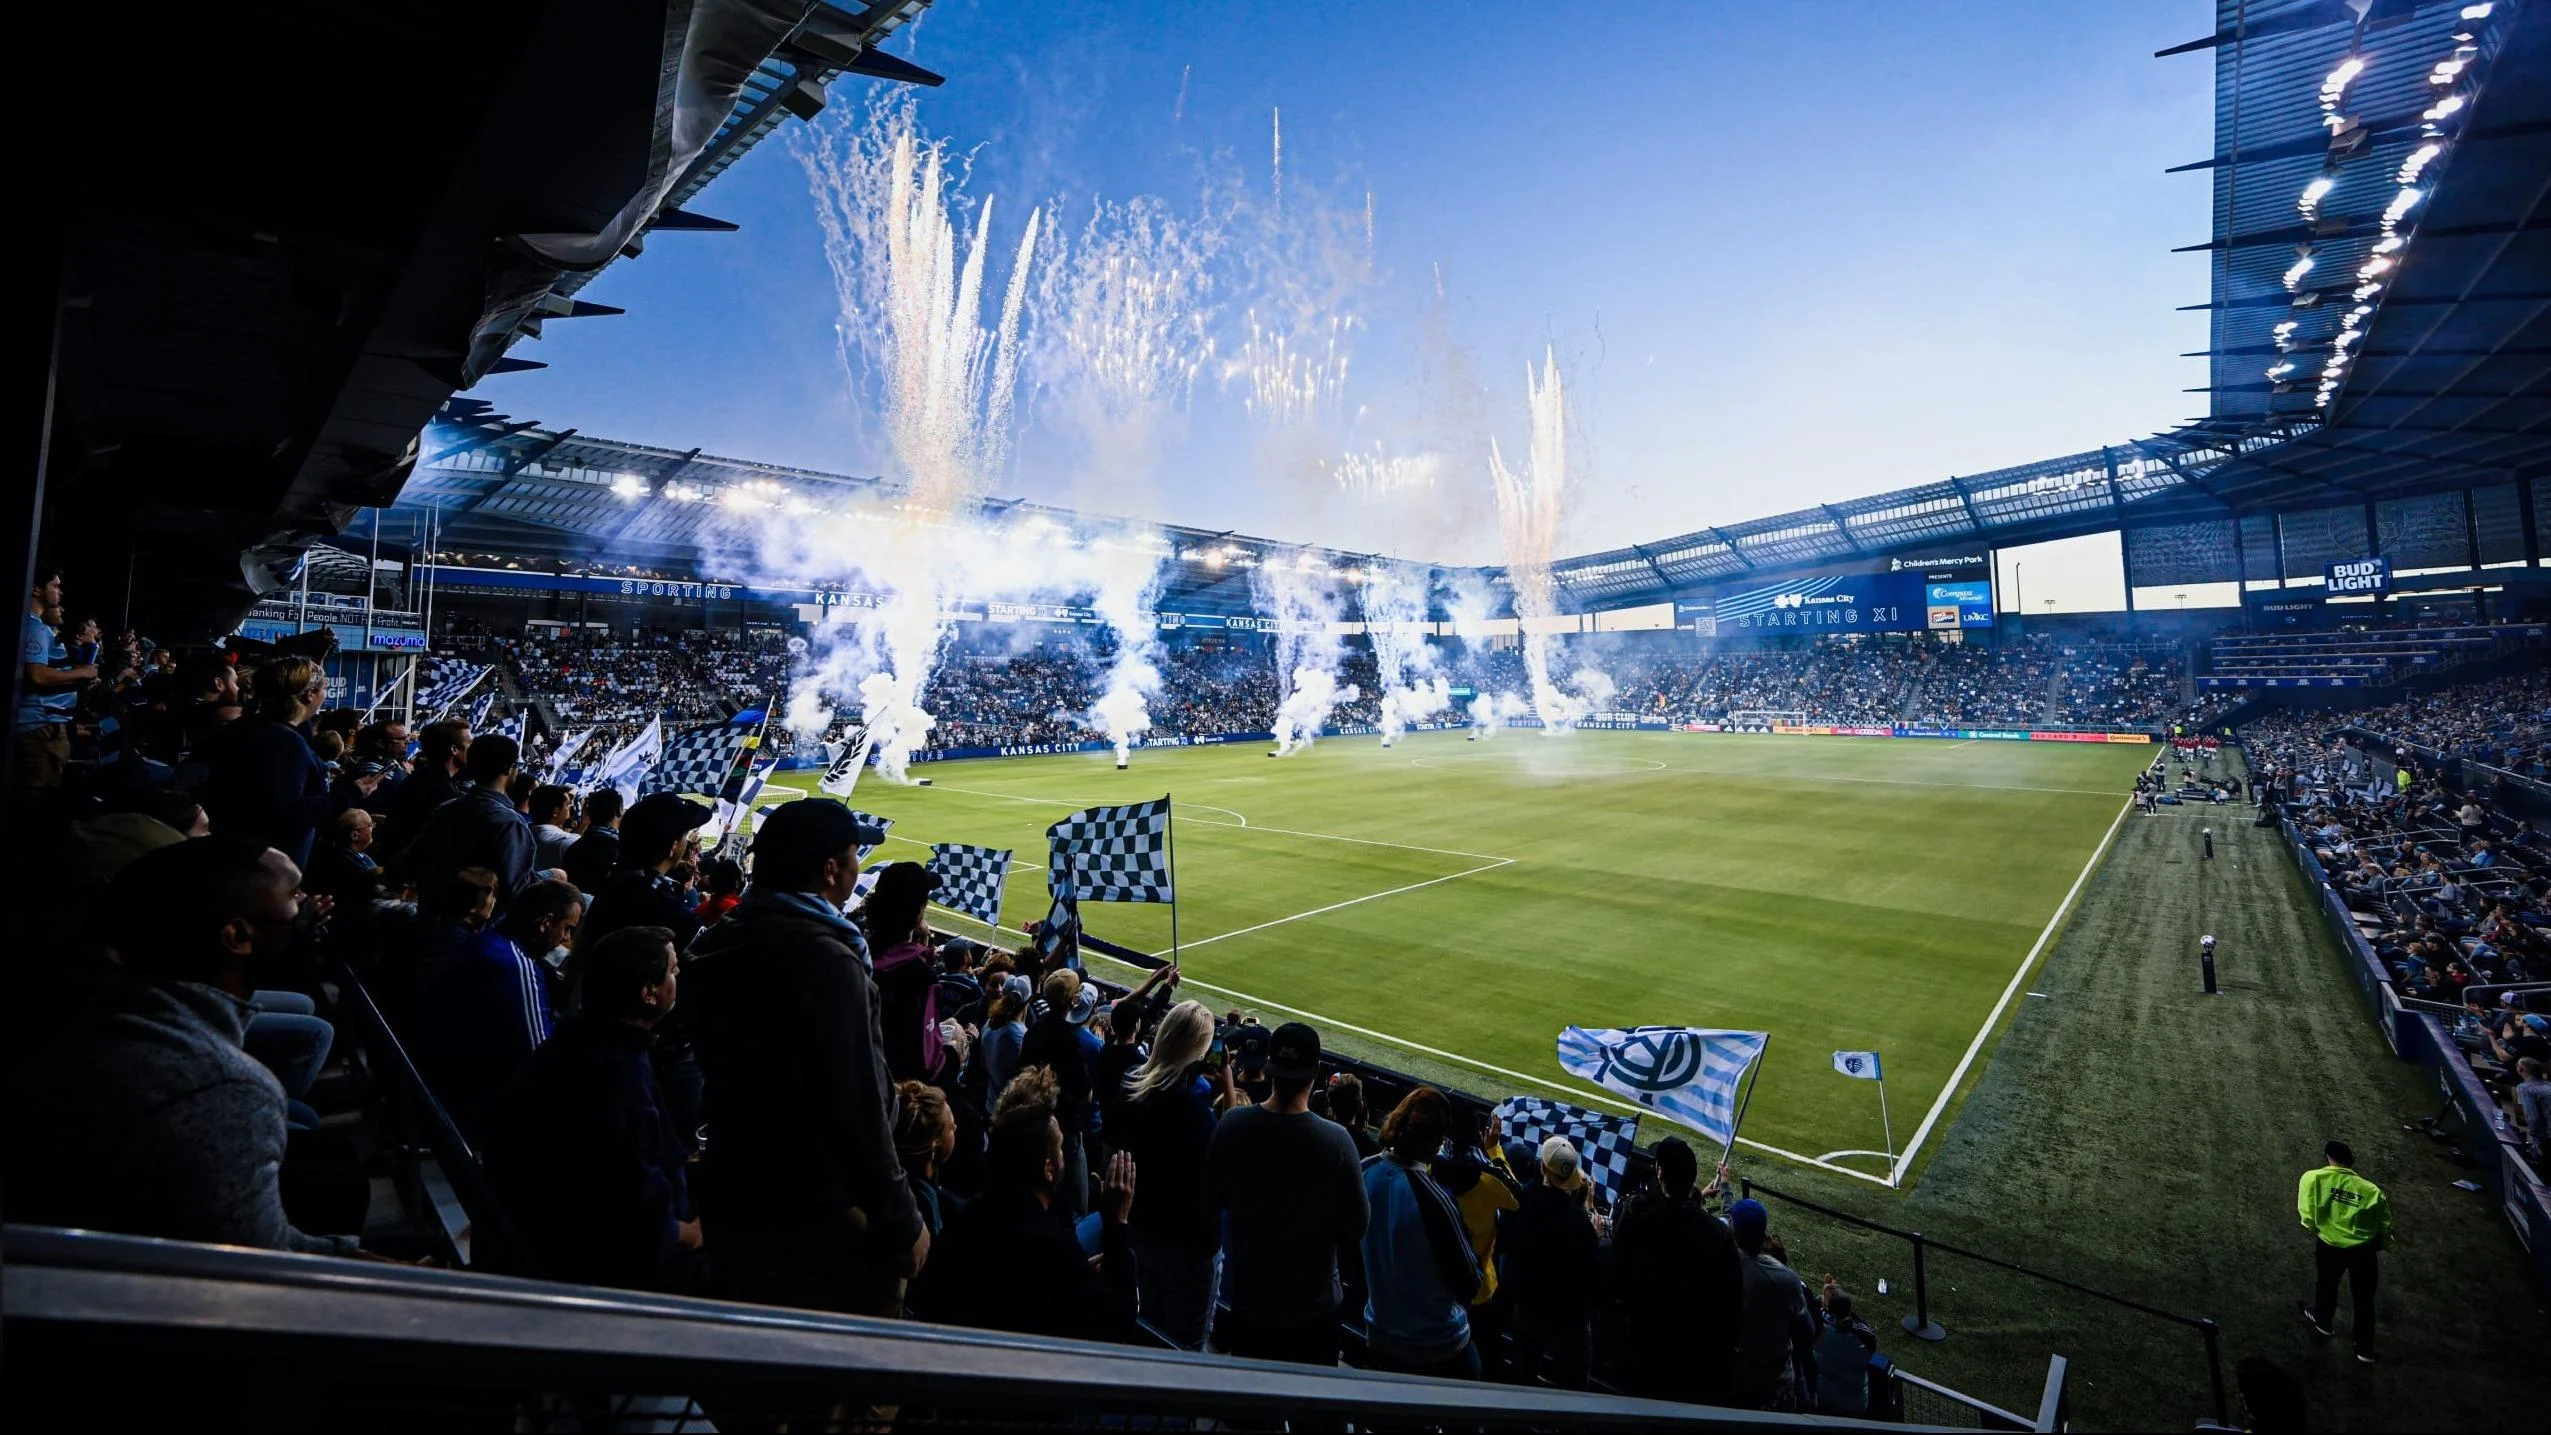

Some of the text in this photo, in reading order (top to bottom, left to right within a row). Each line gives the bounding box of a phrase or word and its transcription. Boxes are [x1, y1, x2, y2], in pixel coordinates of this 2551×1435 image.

[1903, 555, 1983, 568] Children's Mercy Park
[2333, 562, 2374, 578] BUD
[2327, 574, 2383, 592] LIGHT
[620, 580, 731, 600] SPORTING
[815, 592, 885, 609] KANSAS
[1804, 594, 1855, 605] Kansas City
[2285, 603, 2314, 611] LIGHT
[341, 613, 359, 624] NOT
[1226, 618, 1261, 629] KANSAS
[1739, 606, 1898, 628] STARTING XI
[1963, 612, 1989, 622] UMKC
[373, 634, 425, 647] mazuma
[1577, 721, 1637, 730] KANSAS CITY
[1001, 742, 1080, 756] KANSAS CITY
